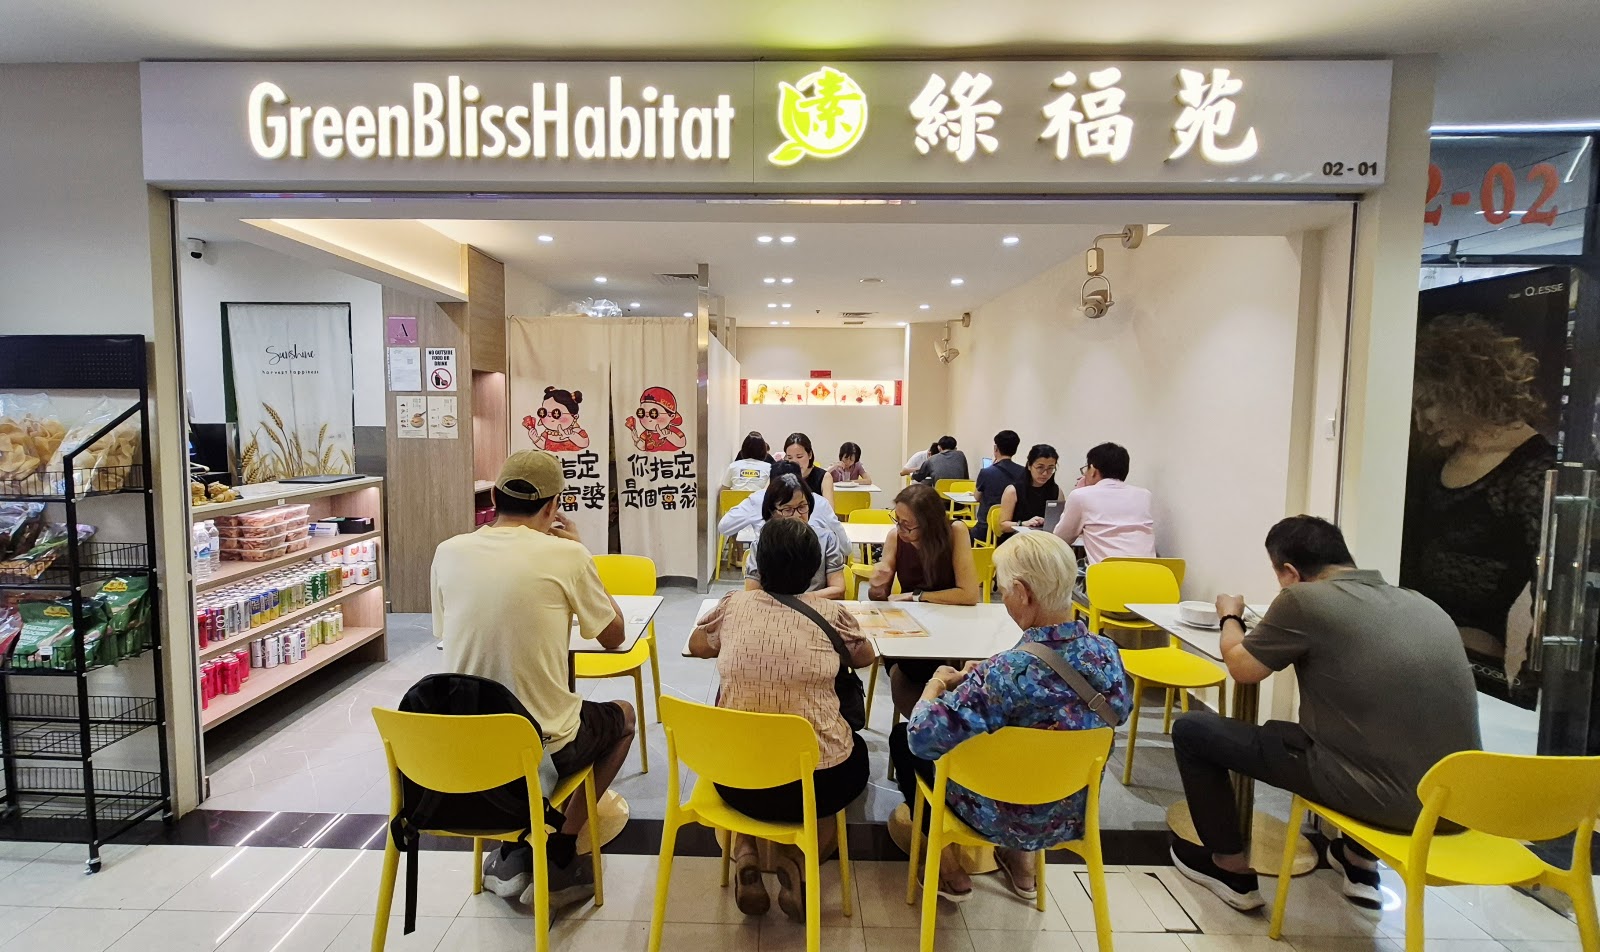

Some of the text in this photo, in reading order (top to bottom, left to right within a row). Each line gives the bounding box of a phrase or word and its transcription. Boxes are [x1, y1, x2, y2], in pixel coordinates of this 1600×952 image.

[248, 75, 735, 159] GreenBlissHabitat
[799, 71, 862, 139] 素
[909, 67, 1258, 163] 綠福苑
[1322, 161, 1378, 176] 02-01
[265, 343, 316, 366] Sunshine
[627, 450, 696, 482] 你指定
[620, 478, 698, 511] 是個富翁
